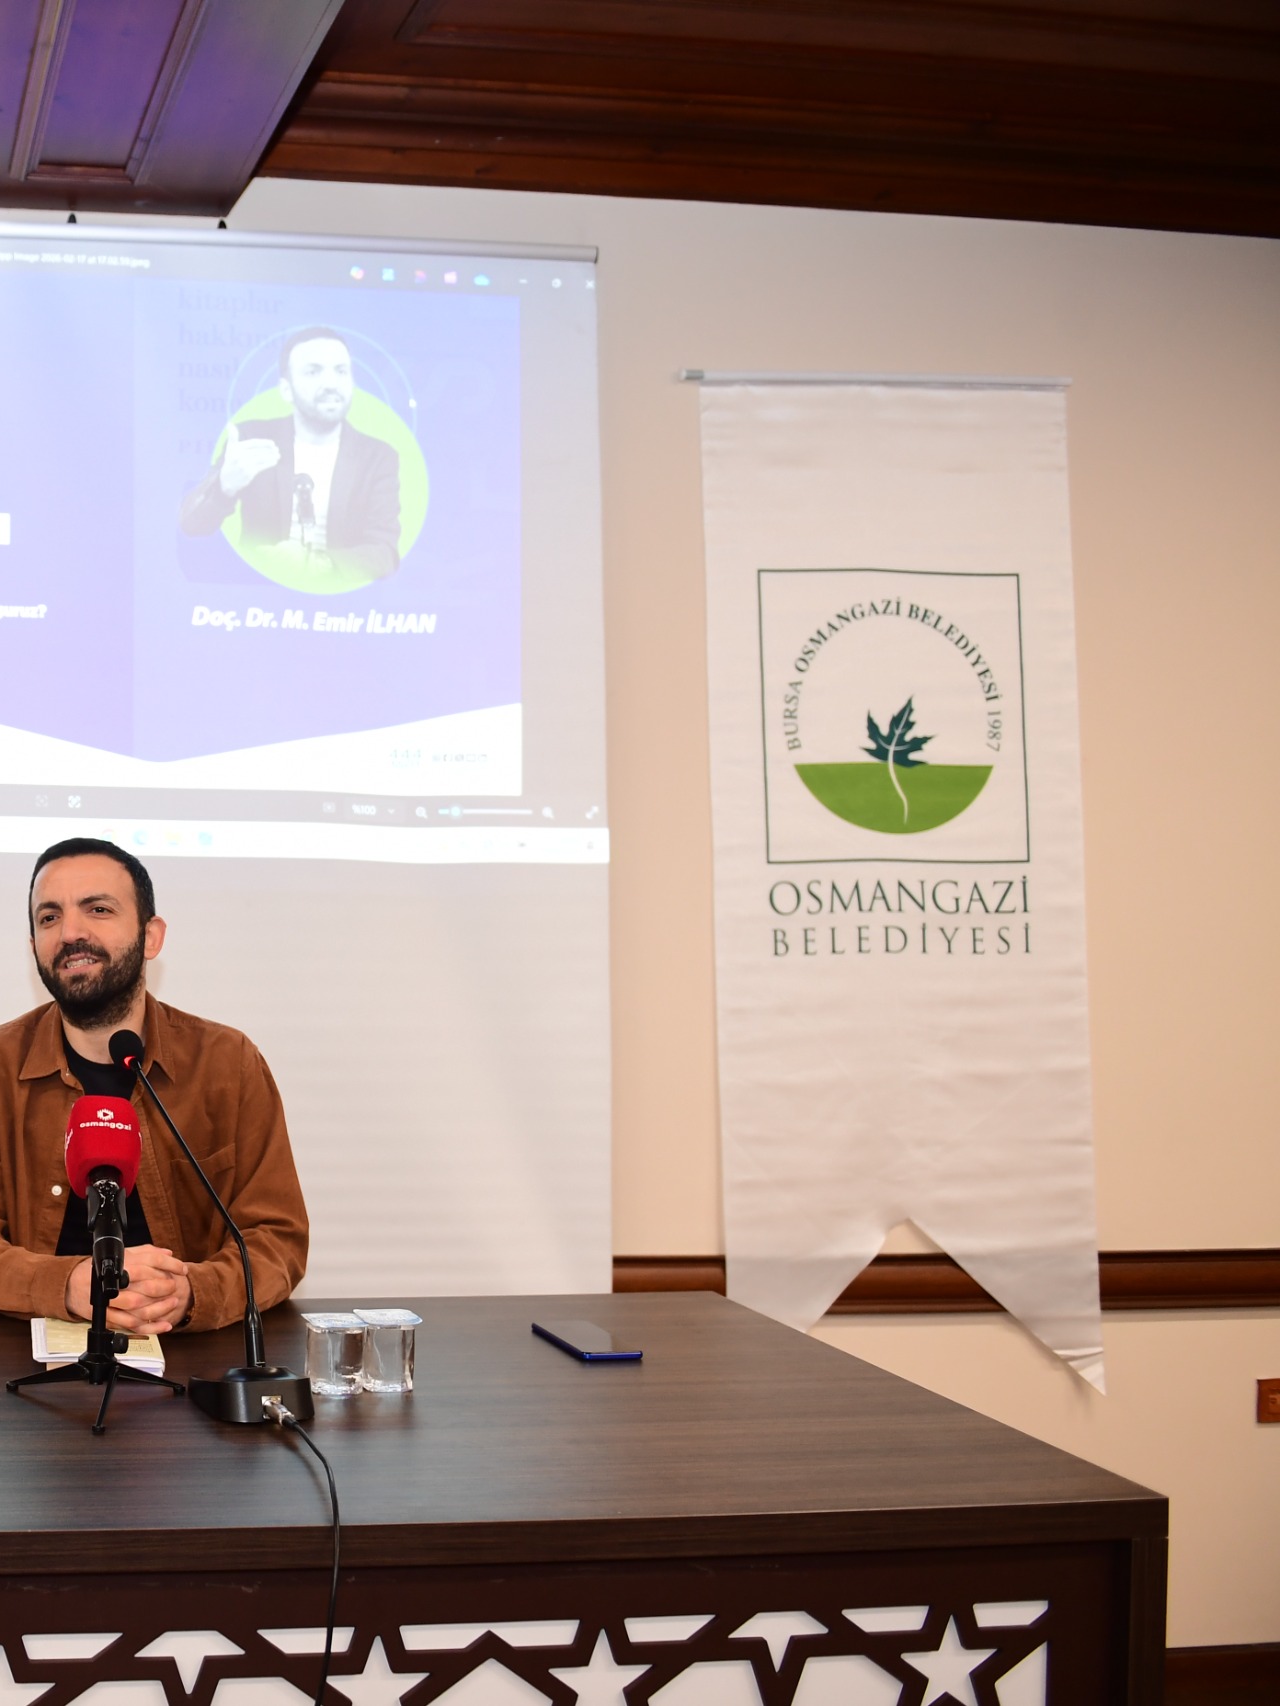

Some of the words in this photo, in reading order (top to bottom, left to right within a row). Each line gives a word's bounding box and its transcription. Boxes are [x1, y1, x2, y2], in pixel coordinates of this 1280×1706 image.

[178, 287, 283, 318] kitaplar
[191, 605, 241, 631] Doç.
[245, 607, 278, 628] Dr.
[282, 609, 308, 630] M.
[312, 611, 365, 633] Emir
[366, 609, 437, 634] İLHAN
[782, 679, 803, 753] BURSA
[793, 595, 902, 674] OSMANGAZİ
[907, 602, 1004, 703] BELEDİYESİ
[986, 709, 1002, 753] 1987
[769, 874, 1030, 917] OSMANGAZİ
[772, 922, 1032, 958] BELEDİYESİ
